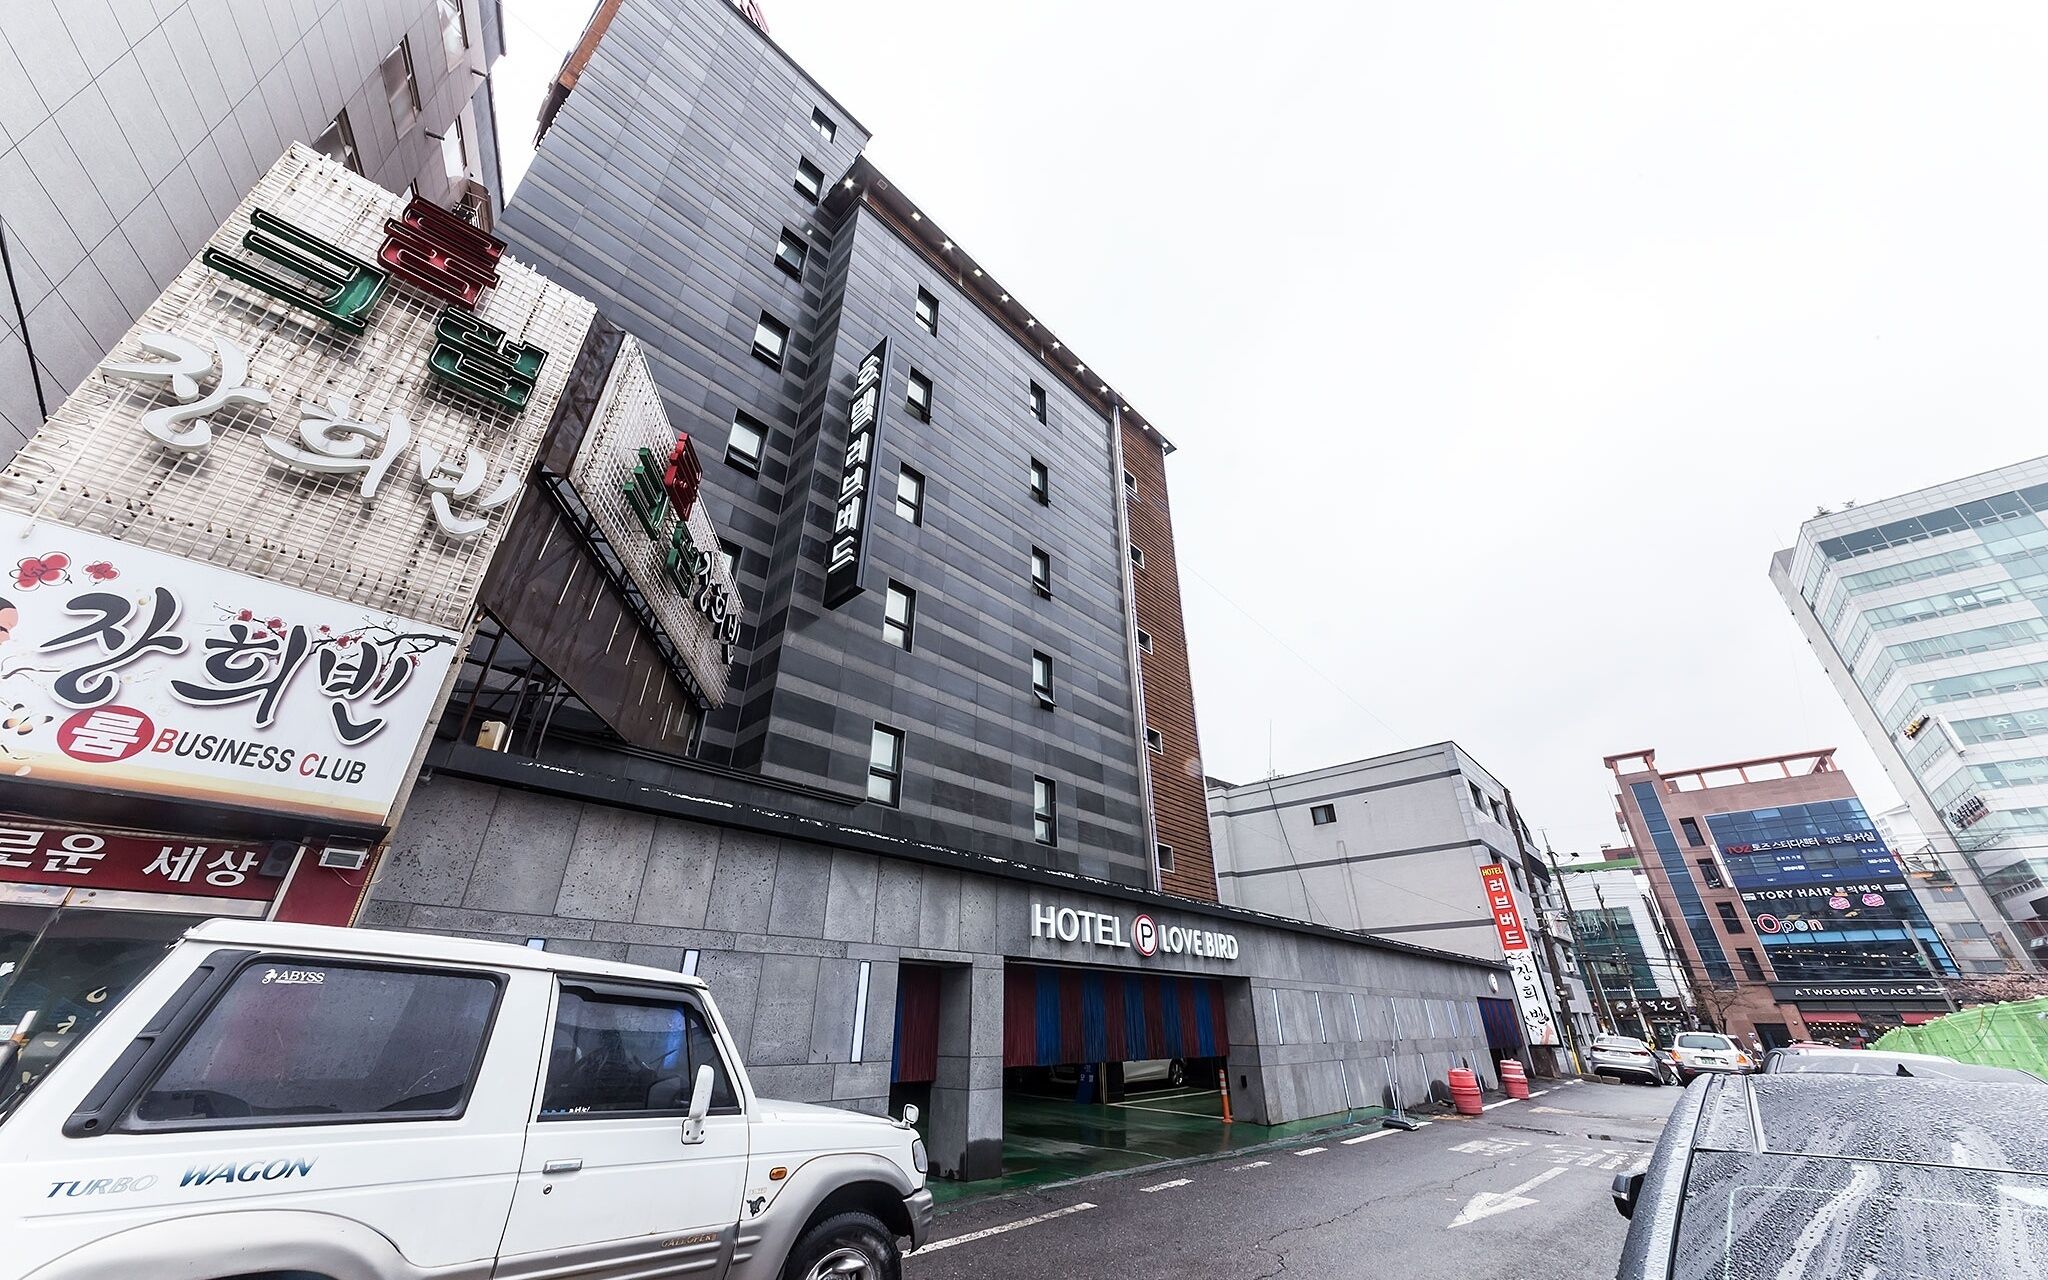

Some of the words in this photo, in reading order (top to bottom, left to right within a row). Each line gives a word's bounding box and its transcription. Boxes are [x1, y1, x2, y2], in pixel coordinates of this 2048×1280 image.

[98, 331, 525, 540] 장희빈
[38, 585, 416, 747] 장희빈
[69, 710, 145, 758] 룸
[151, 728, 296, 773] BUSINESS
[299, 752, 367, 784] CLUB
[142, 846, 259, 887] 세상
[1481, 867, 1504, 877] HOTEL
[1489, 878, 1523, 945] 러브버드
[1757, 889, 1794, 900] TORY
[1797, 887, 1833, 898] HAIR
[1031, 903, 1130, 948] HOTEL
[1757, 913, 1824, 934] Open
[278, 970, 325, 982] ABYSS
[1516, 963, 1550, 1025] 장희빈
[1870, 987, 1916, 996] PLACE
[47, 1174, 159, 1198] TURBO
[179, 1153, 319, 1188] WAGON
